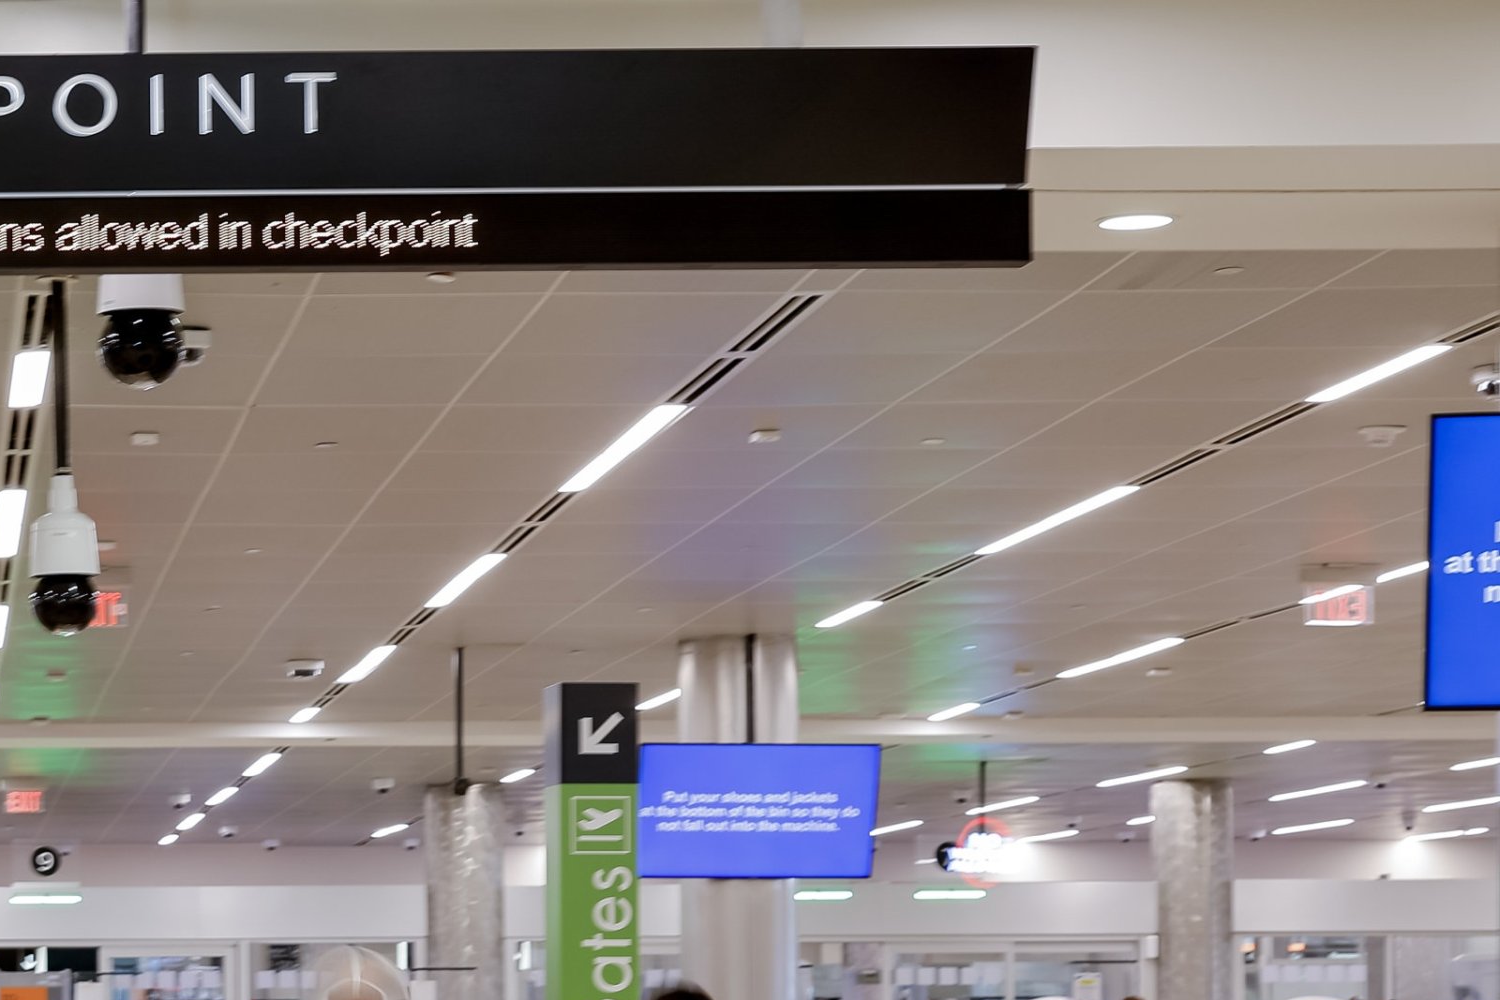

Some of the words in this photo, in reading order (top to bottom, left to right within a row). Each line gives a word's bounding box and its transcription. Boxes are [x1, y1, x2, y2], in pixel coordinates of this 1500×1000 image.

[55, 212, 209, 252] allowed
[218, 212, 252, 250] in
[262, 210, 479, 257] checkpoint
[662, 790, 688, 803] Put
[689, 793, 721, 806] your
[720, 791, 763, 803] shoes
[763, 791, 791, 803] and
[788, 791, 839, 806] jackets
[637, 806, 655, 818] at
[655, 805, 678, 817] the
[677, 805, 728, 818] bottom
[728, 804, 745, 817] of
[745, 805, 766, 817] the
[766, 805, 791, 817] bin
[791, 807, 810, 818] so
[810, 805, 840, 820] they
[840, 805, 861, 817] do
[656, 820, 681, 832] not
[681, 819, 704, 832] fall
[704, 820, 729, 832] out
[729, 820, 756, 832] into
[755, 820, 780, 832] the
[35, 851, 55, 872] 9
